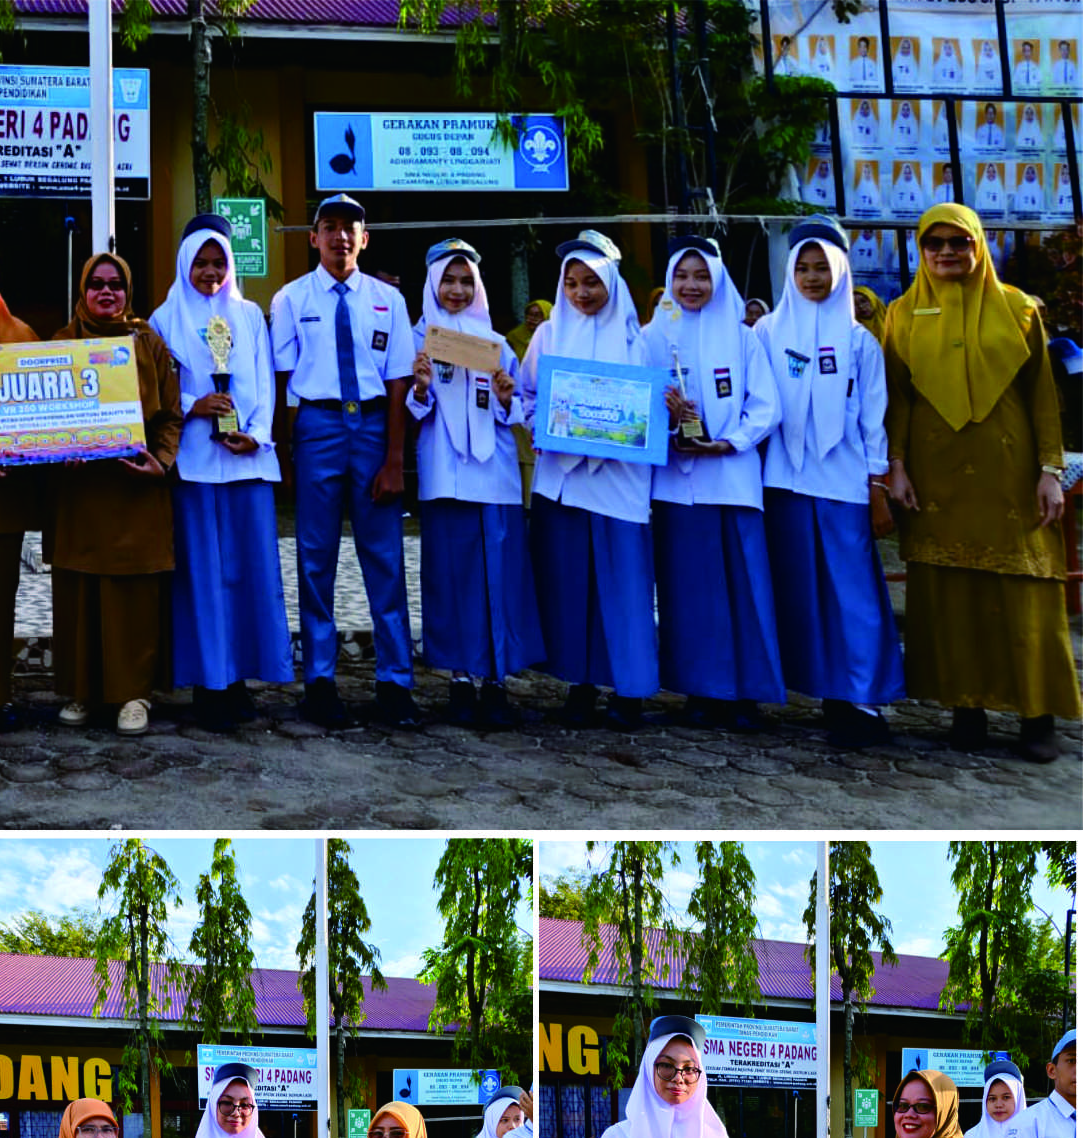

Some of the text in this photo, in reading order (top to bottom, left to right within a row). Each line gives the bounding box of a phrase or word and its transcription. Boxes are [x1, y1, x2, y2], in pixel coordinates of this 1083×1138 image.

[20, 76, 63, 87] SUMATERA
[33, 111, 44, 140] 4
[50, 112, 131, 142] PADG
[382, 119, 439, 130] GERAKAN
[80, 368, 100, 398] 3
[38, 400, 96, 413] WORKSHOP
[703, 1039, 817, 1061] SMA NEGERI 4 PADANG
[730, 1059, 780, 1068] TERAKREDITASI
[267, 1069, 312, 1084] 4 PADANG
